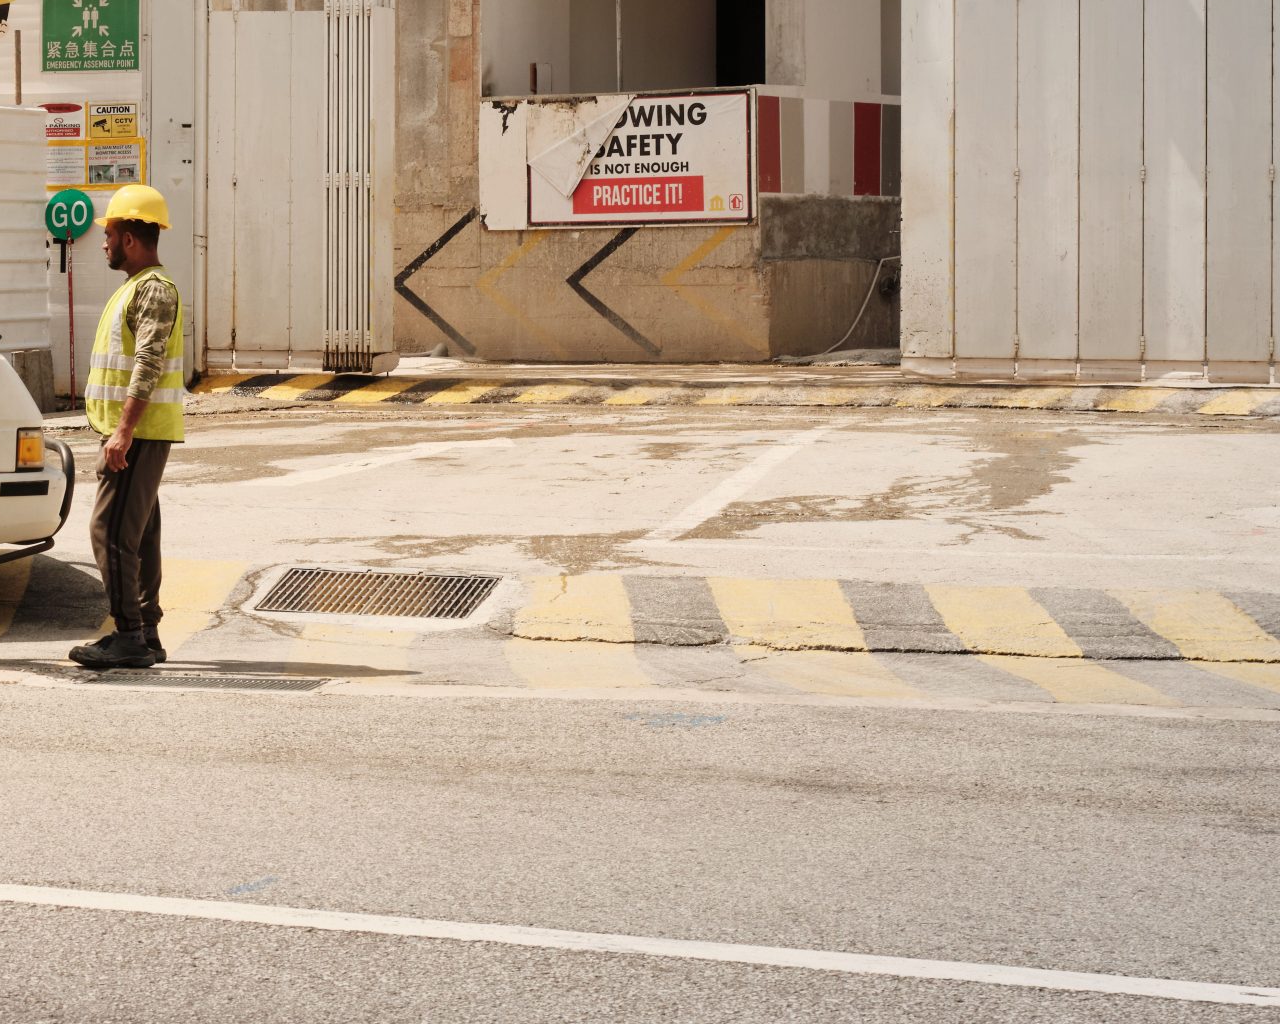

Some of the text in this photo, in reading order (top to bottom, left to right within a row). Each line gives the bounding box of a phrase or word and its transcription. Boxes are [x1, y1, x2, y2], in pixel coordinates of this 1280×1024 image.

[47, 40, 135, 59] 紧急集合点
[46, 59, 135, 69] EMERGENCY ASSEMBLY POINT
[96, 106, 130, 114] CAUTION
[590, 161, 689, 175] IS NOT ENOUGH
[593, 183, 683, 206] PRACTICE IT!
[51, 201, 88, 228] GO
